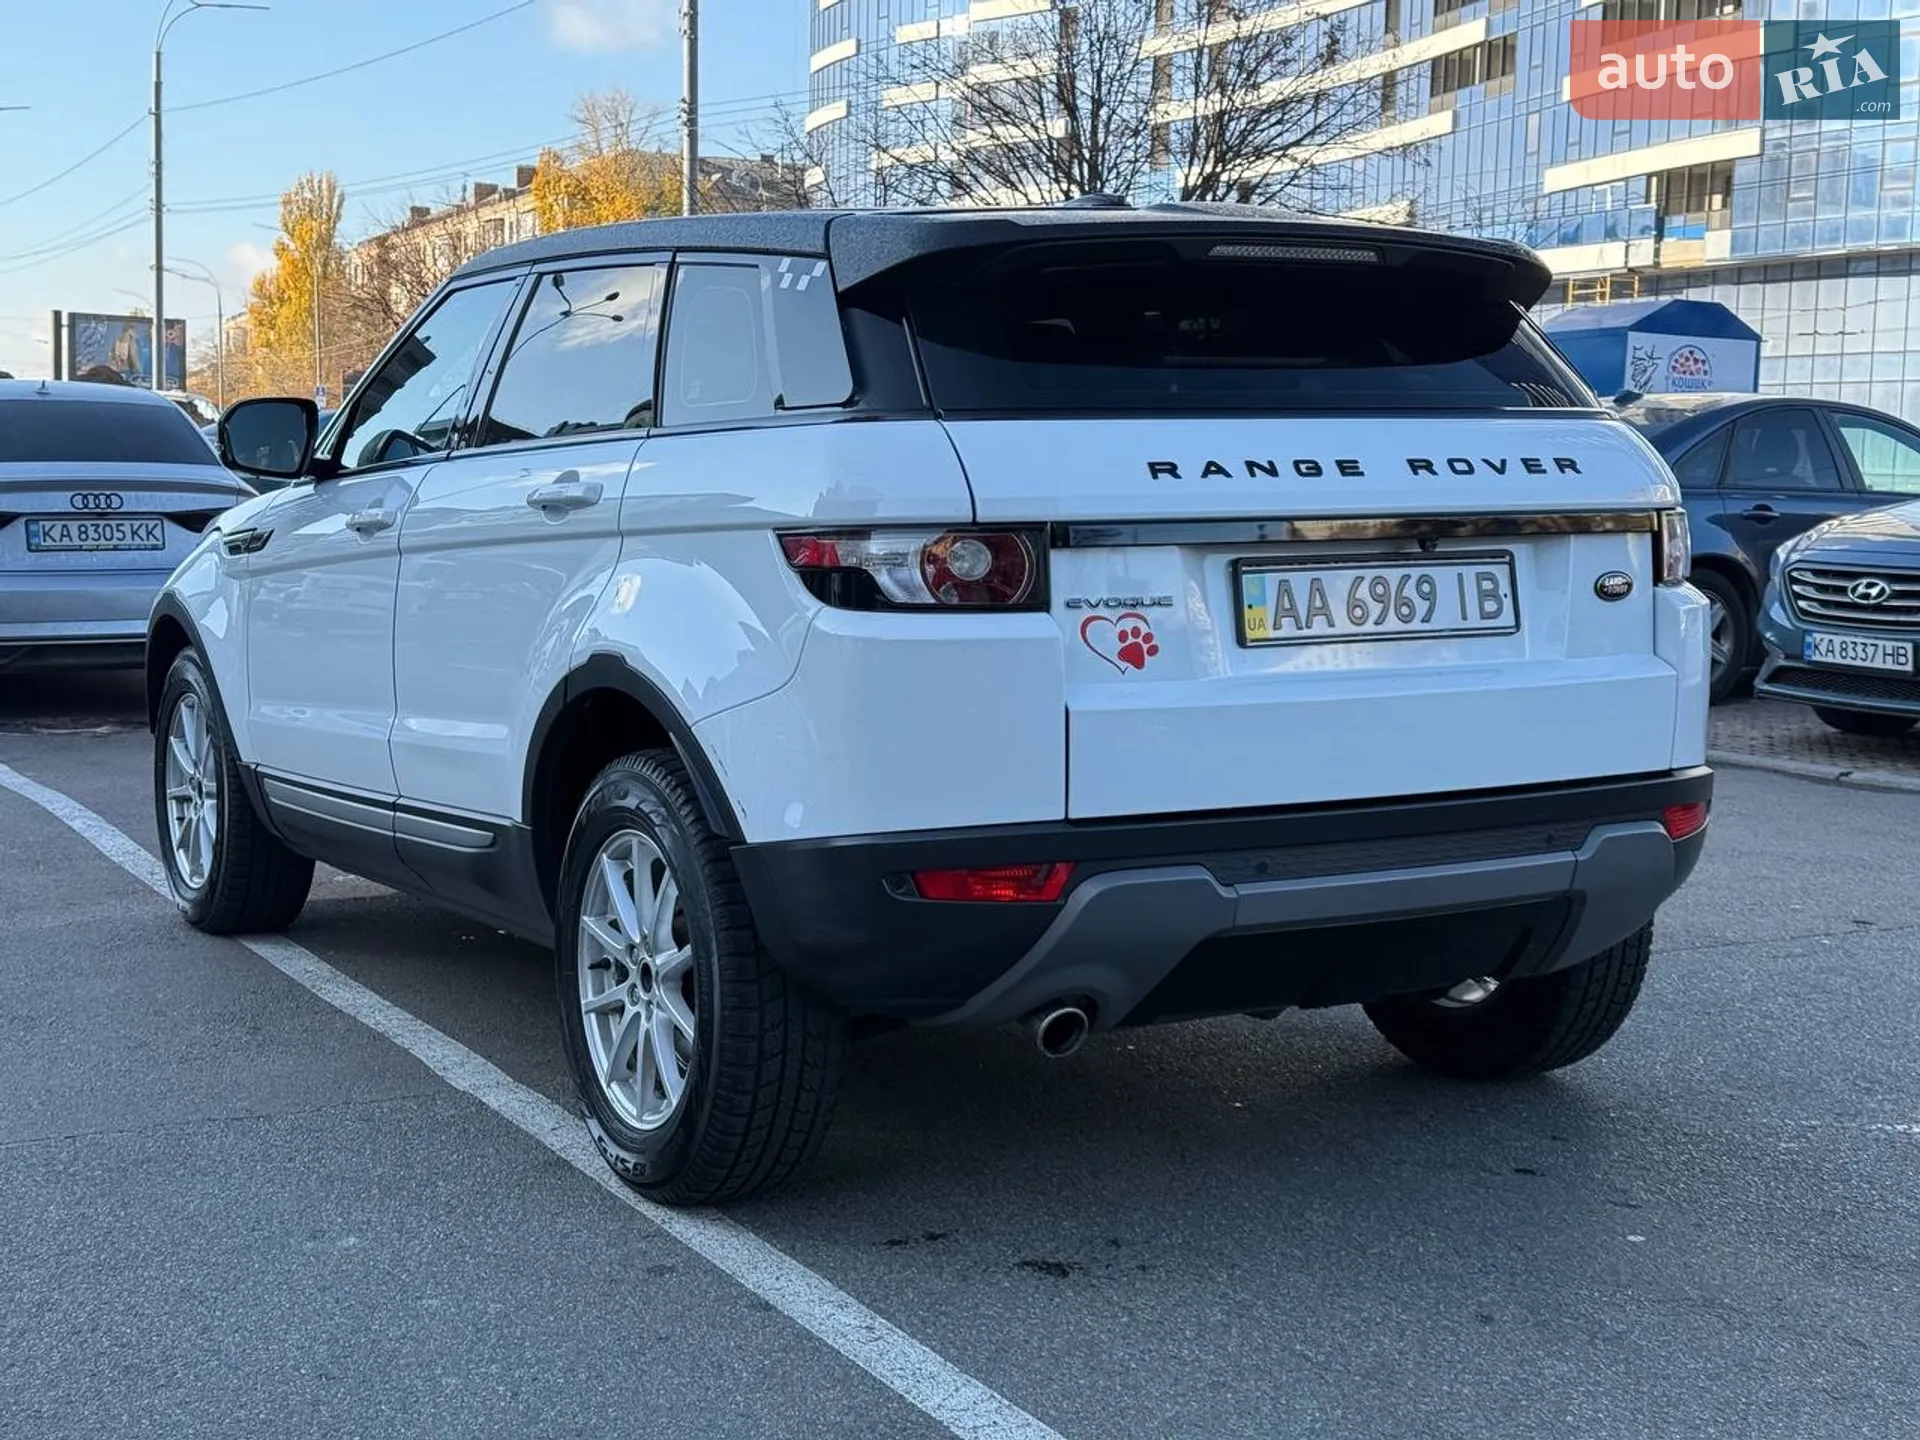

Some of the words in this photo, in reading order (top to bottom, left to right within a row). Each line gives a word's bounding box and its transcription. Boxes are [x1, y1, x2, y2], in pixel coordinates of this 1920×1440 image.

[1147, 459, 1365, 480] RANGE
[1407, 457, 1583, 476] ROVER
[41, 523, 74, 543] KA
[77, 523, 126, 542] 8305
[130, 523, 160, 542] KK
[1065, 596, 1174, 609] EVOQUE
[1272, 578, 1336, 631] AA
[1346, 574, 1437, 627] 6969
[1457, 571, 1504, 621] IB
[1247, 616, 1267, 632] UA
[1813, 637, 1836, 660] KA
[1839, 640, 1878, 663] 8337
[1882, 643, 1909, 666] HB
